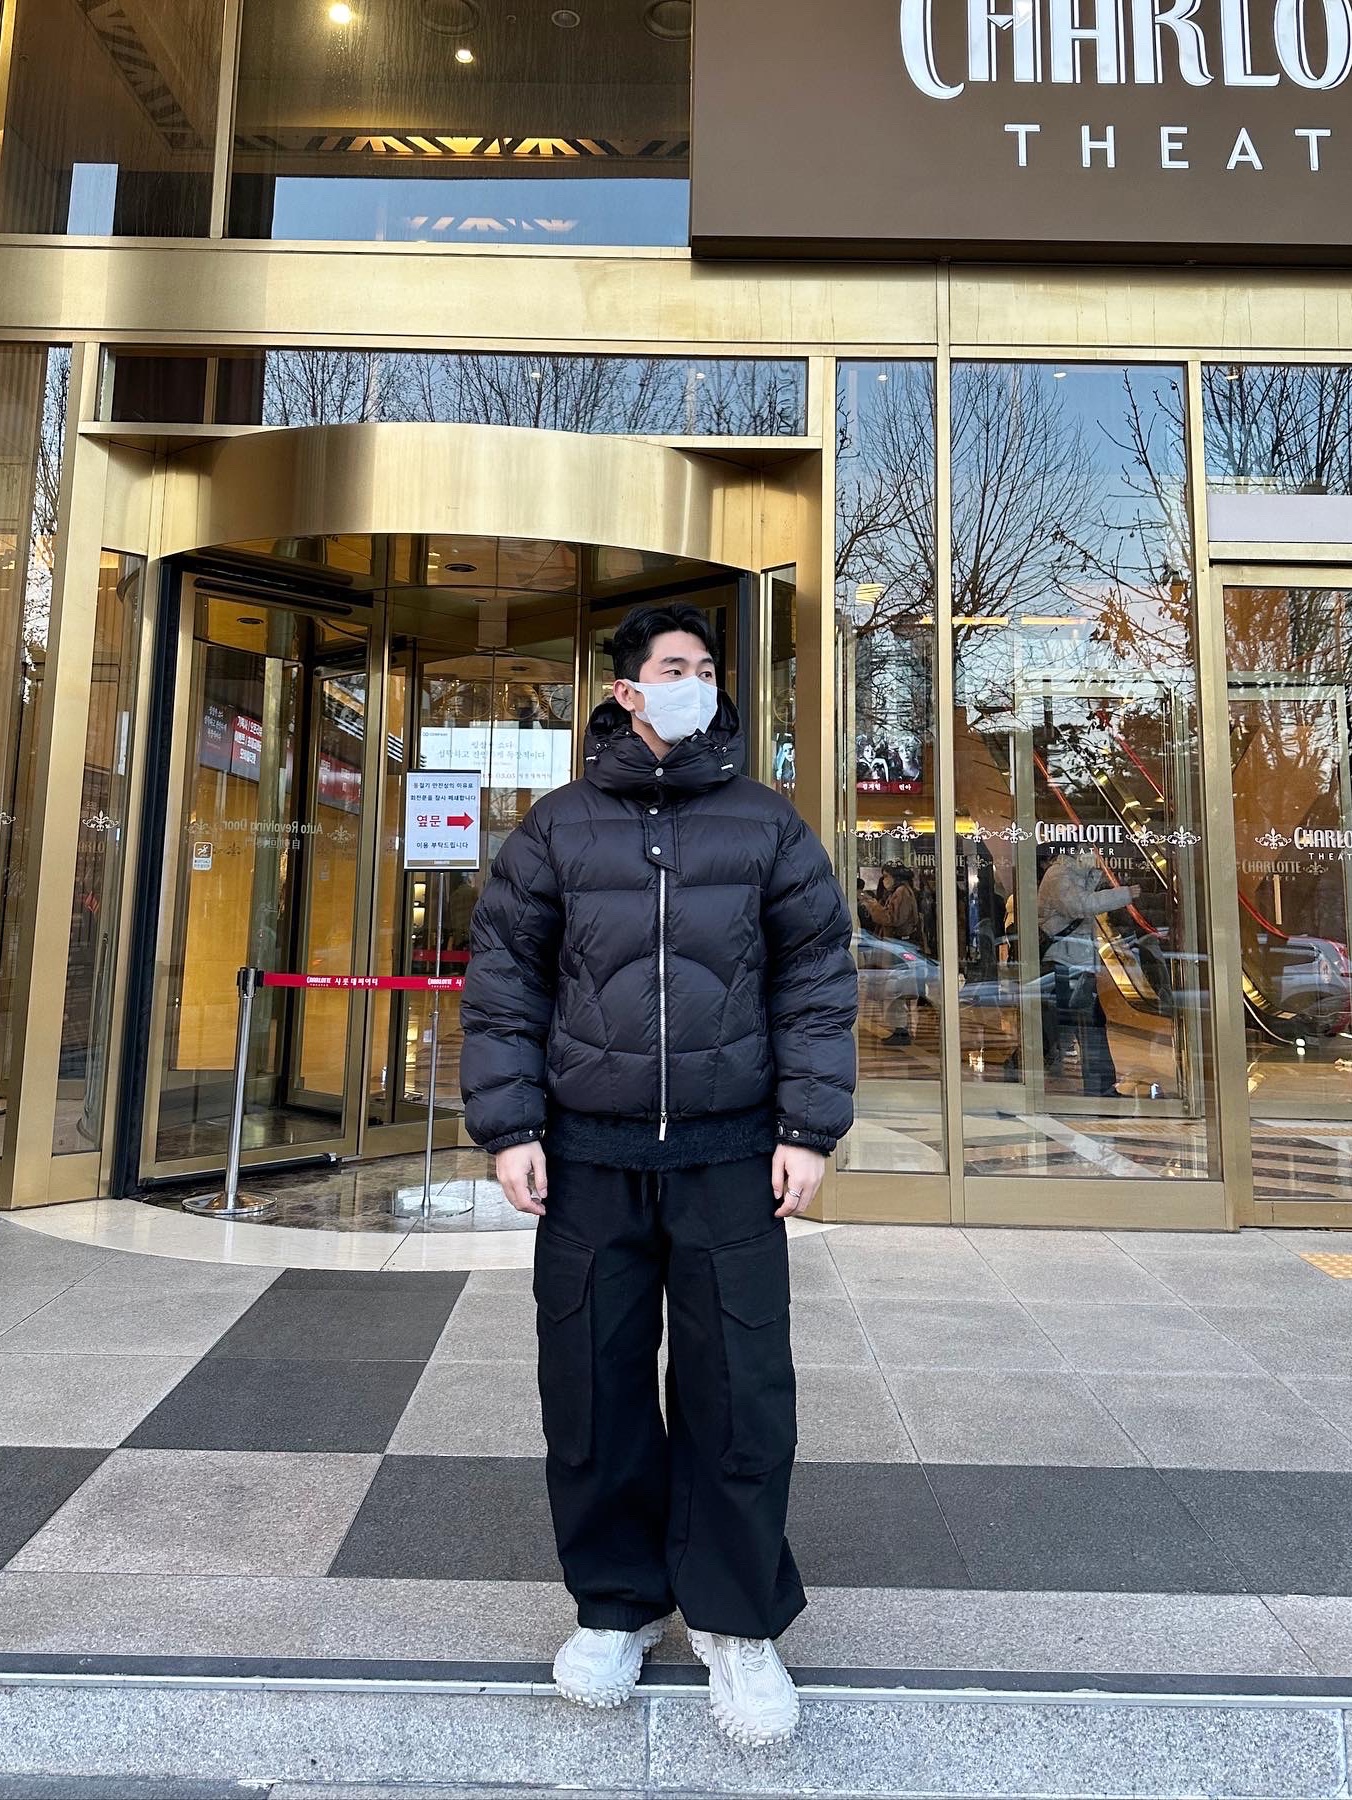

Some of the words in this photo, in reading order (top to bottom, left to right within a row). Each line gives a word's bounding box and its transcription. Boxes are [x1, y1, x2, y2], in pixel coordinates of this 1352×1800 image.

[1004, 124, 1332, 171] THEAT
[416, 815, 441, 828] 옆문
[1035, 821, 1123, 844] CHARLOTTE
[1293, 826, 1352, 850] CHARLO
[1049, 846, 1115, 856] THEATER
[1241, 860, 1301, 874] CHARLOTTE
